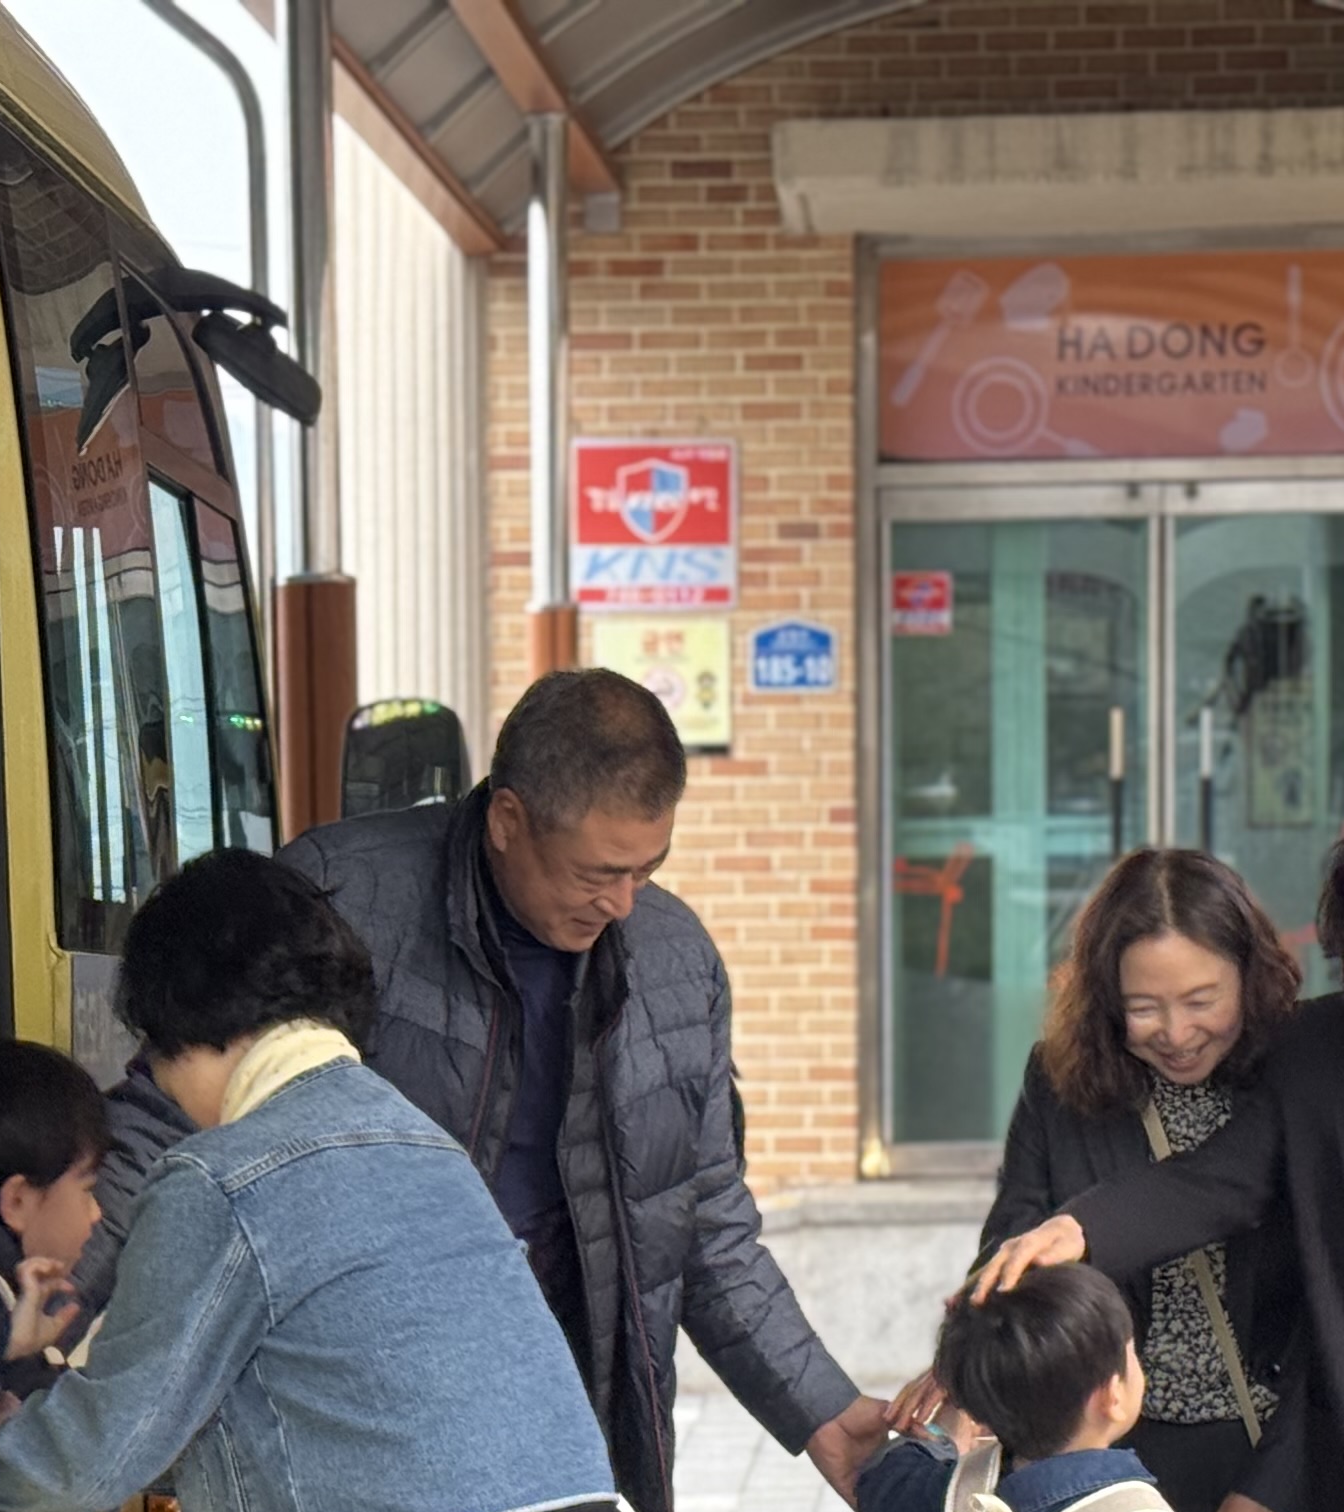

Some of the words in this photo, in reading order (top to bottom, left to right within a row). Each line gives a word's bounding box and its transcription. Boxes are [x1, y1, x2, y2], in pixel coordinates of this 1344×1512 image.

[1056, 323, 1113, 362] HA
[1124, 320, 1267, 360] DONG
[1055, 369, 1269, 398] KINDERGARTEN
[584, 549, 725, 582] KNS
